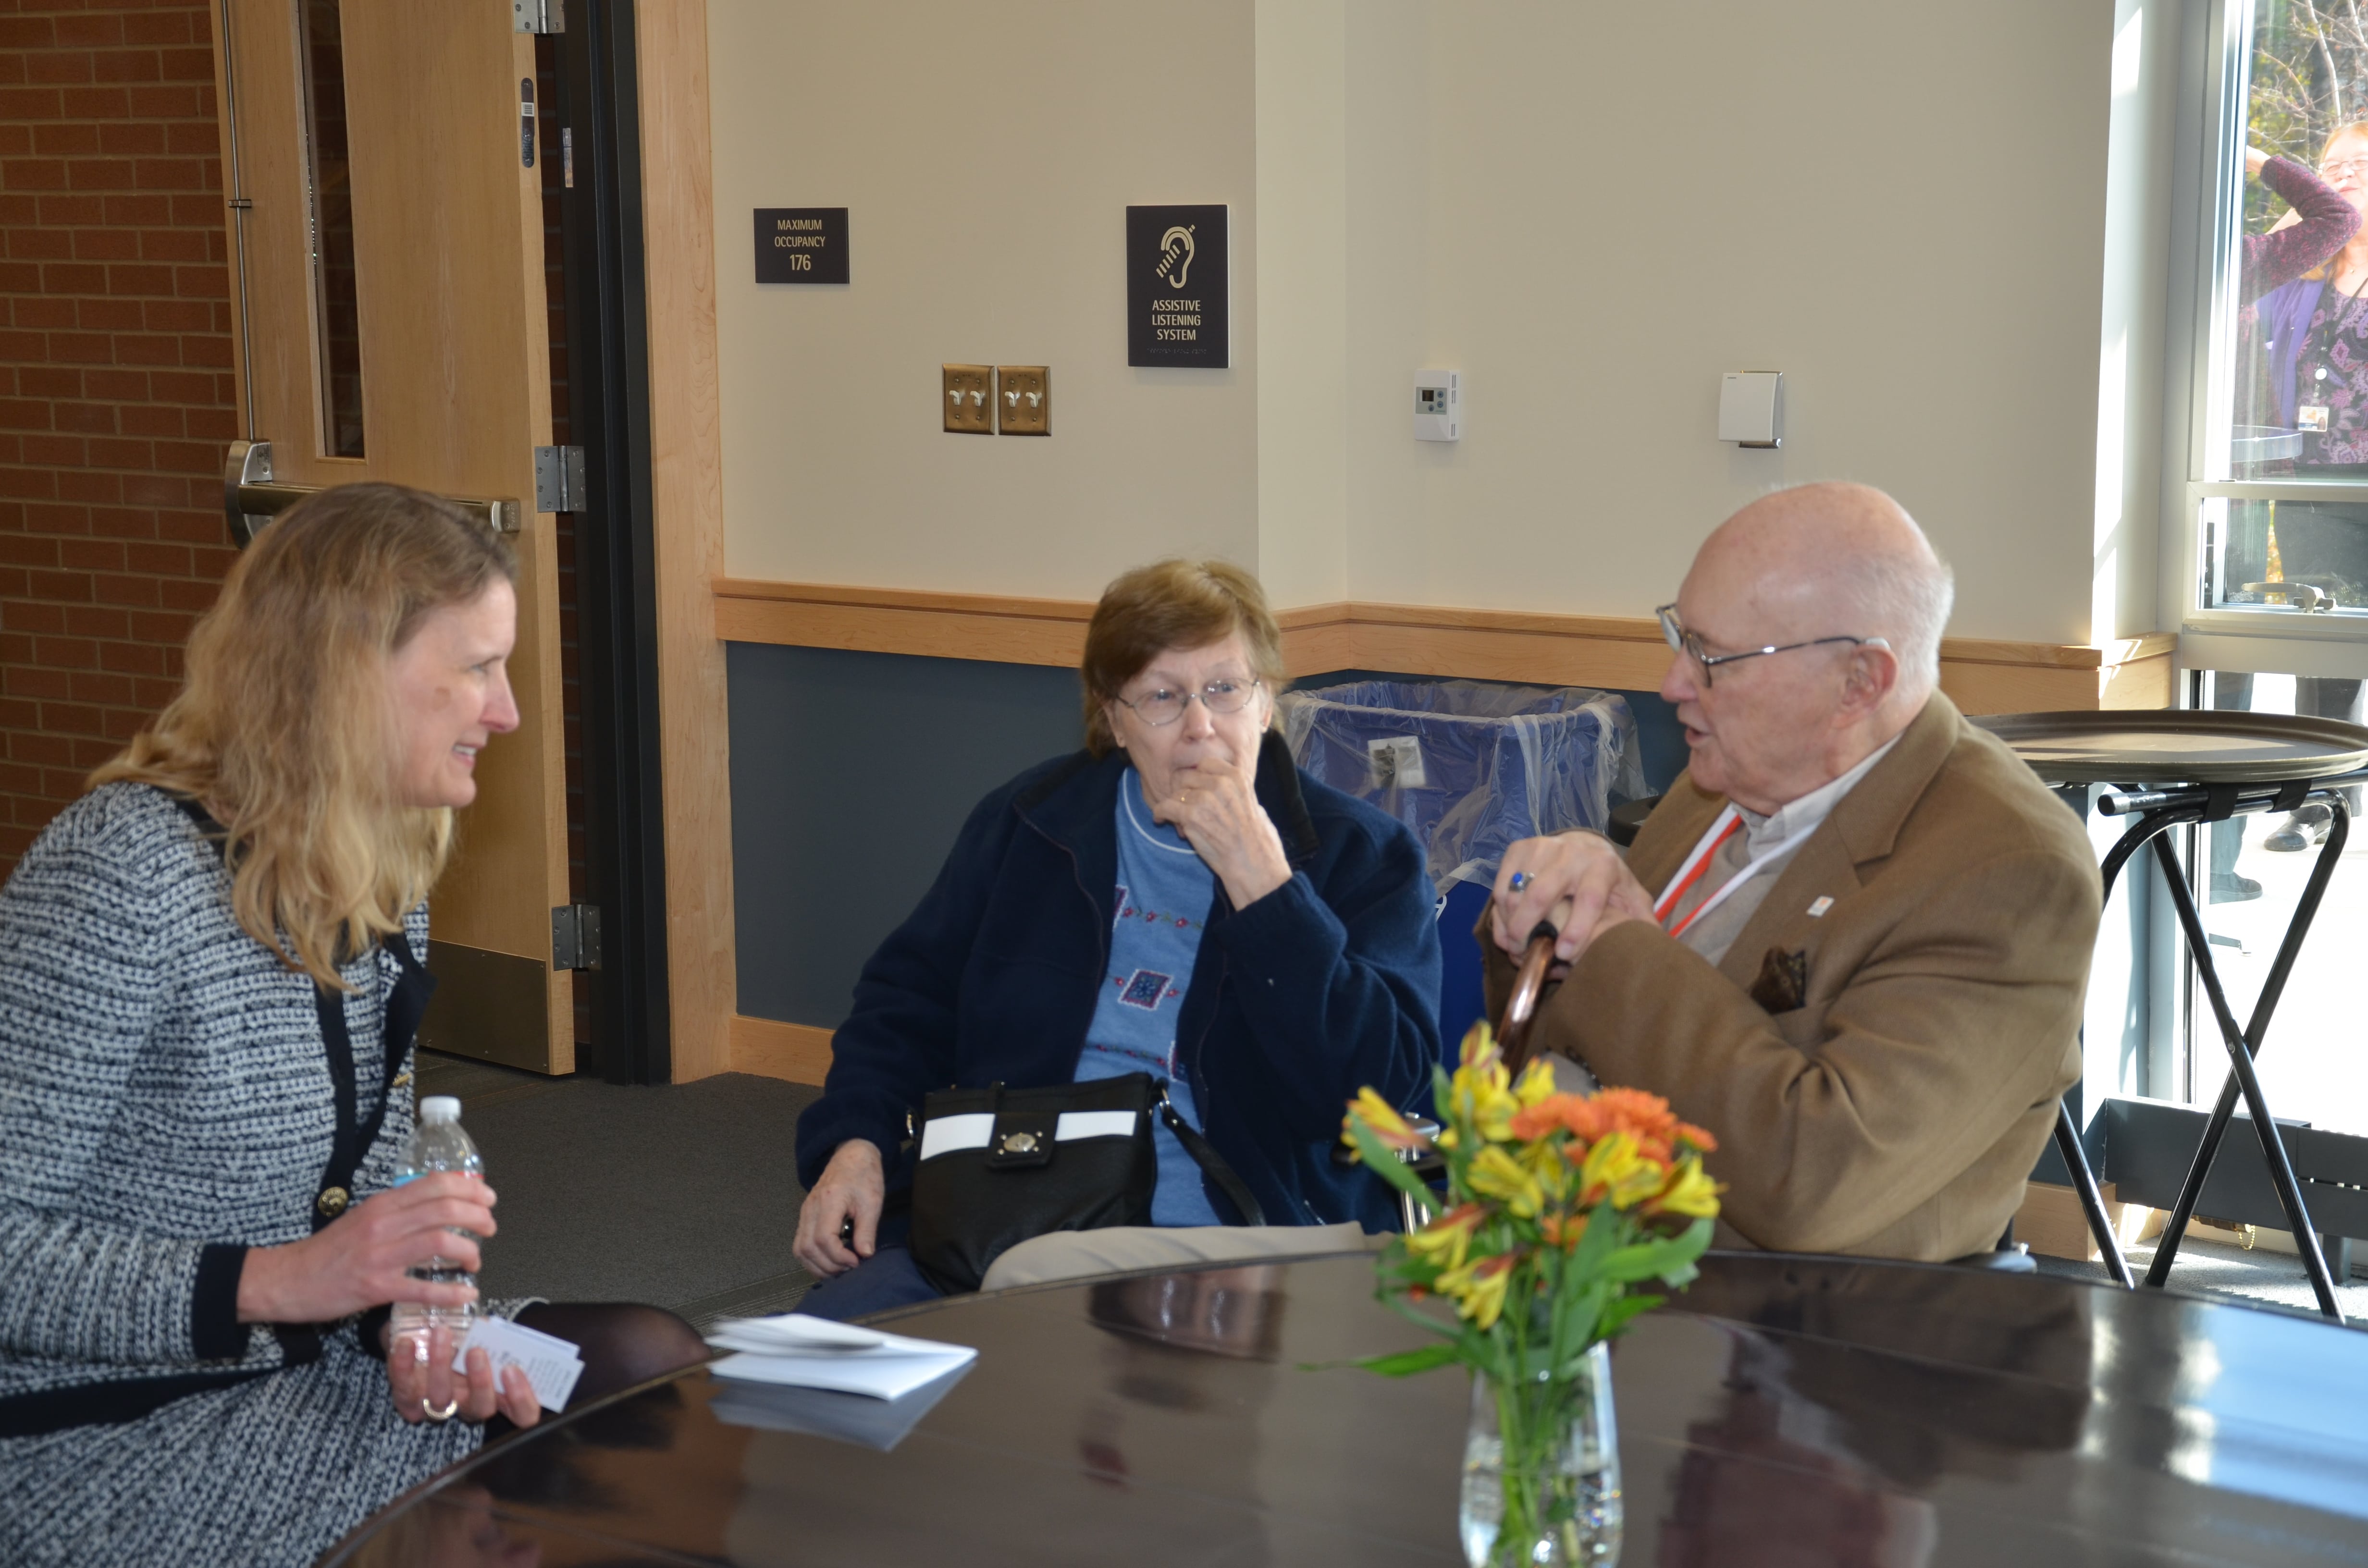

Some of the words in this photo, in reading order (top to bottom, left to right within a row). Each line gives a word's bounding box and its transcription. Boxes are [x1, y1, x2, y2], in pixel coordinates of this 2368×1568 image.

[777, 220, 822, 230] MAXIMUM
[775, 236, 826, 247] OCCUPANCY
[789, 254, 811, 270] 176
[1152, 300, 1201, 311] ASSISTIVE
[1152, 314, 1201, 326] LISTENING
[1157, 329, 1196, 341] SYSTEM
